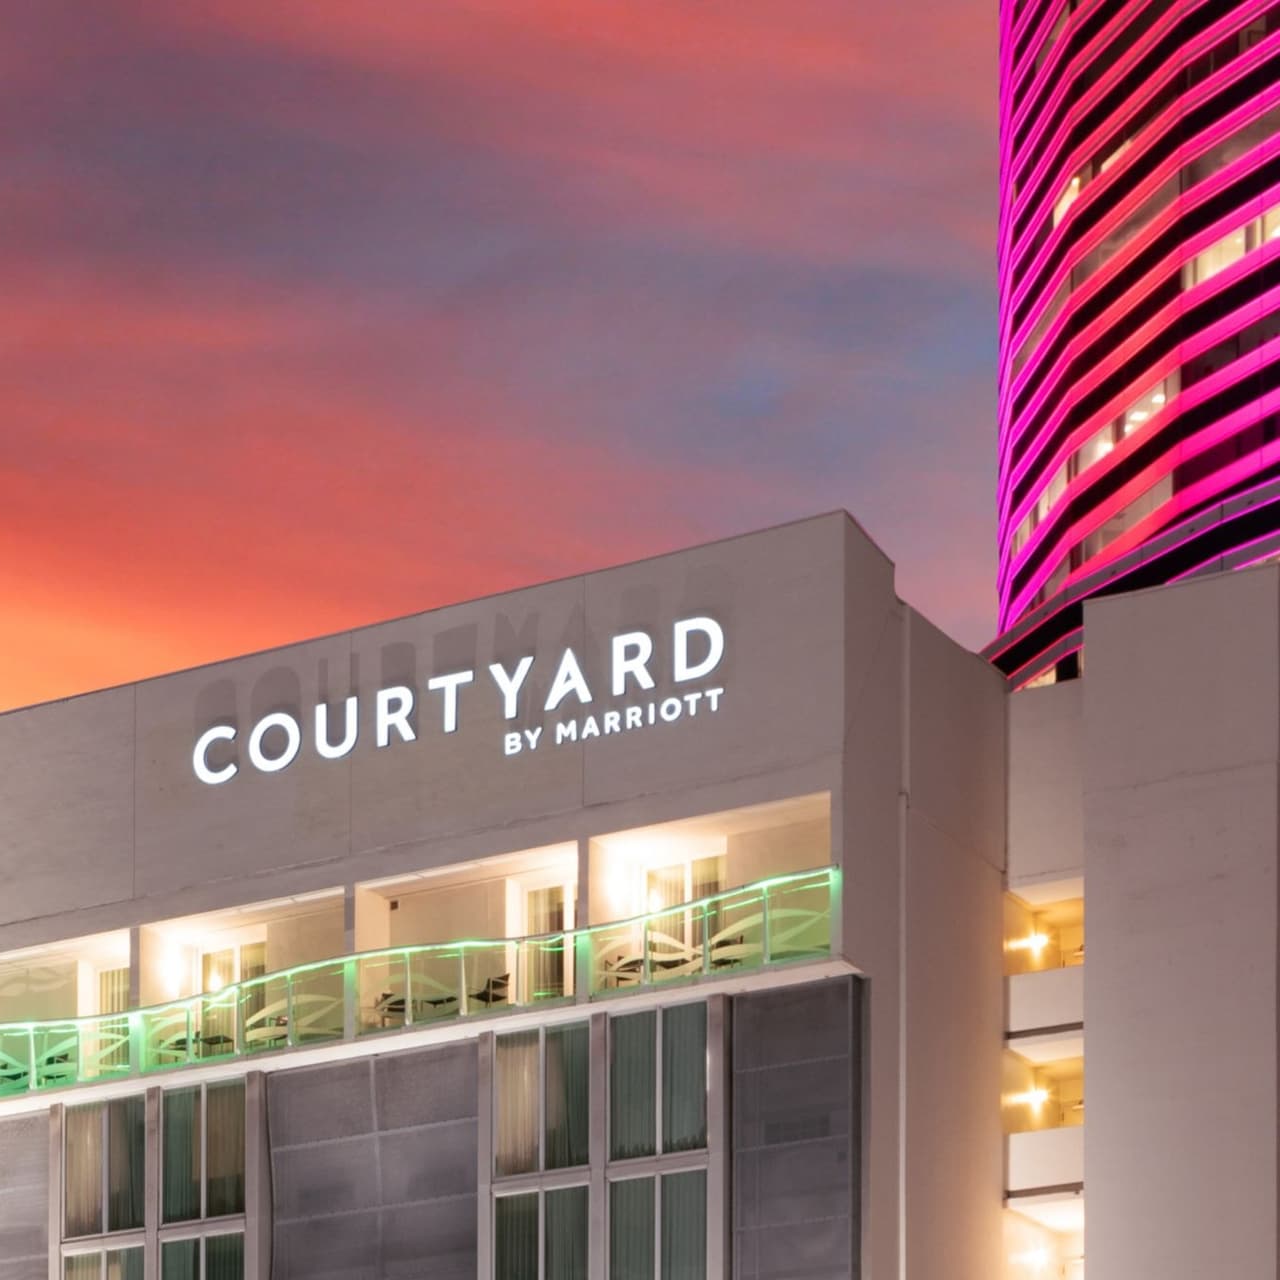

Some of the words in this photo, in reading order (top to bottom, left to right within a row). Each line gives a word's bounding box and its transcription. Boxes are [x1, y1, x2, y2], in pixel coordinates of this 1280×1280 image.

[192, 616, 725, 785] COURTYARD
[504, 726, 542, 756] BY
[556, 687, 724, 745] MARRIOTT
